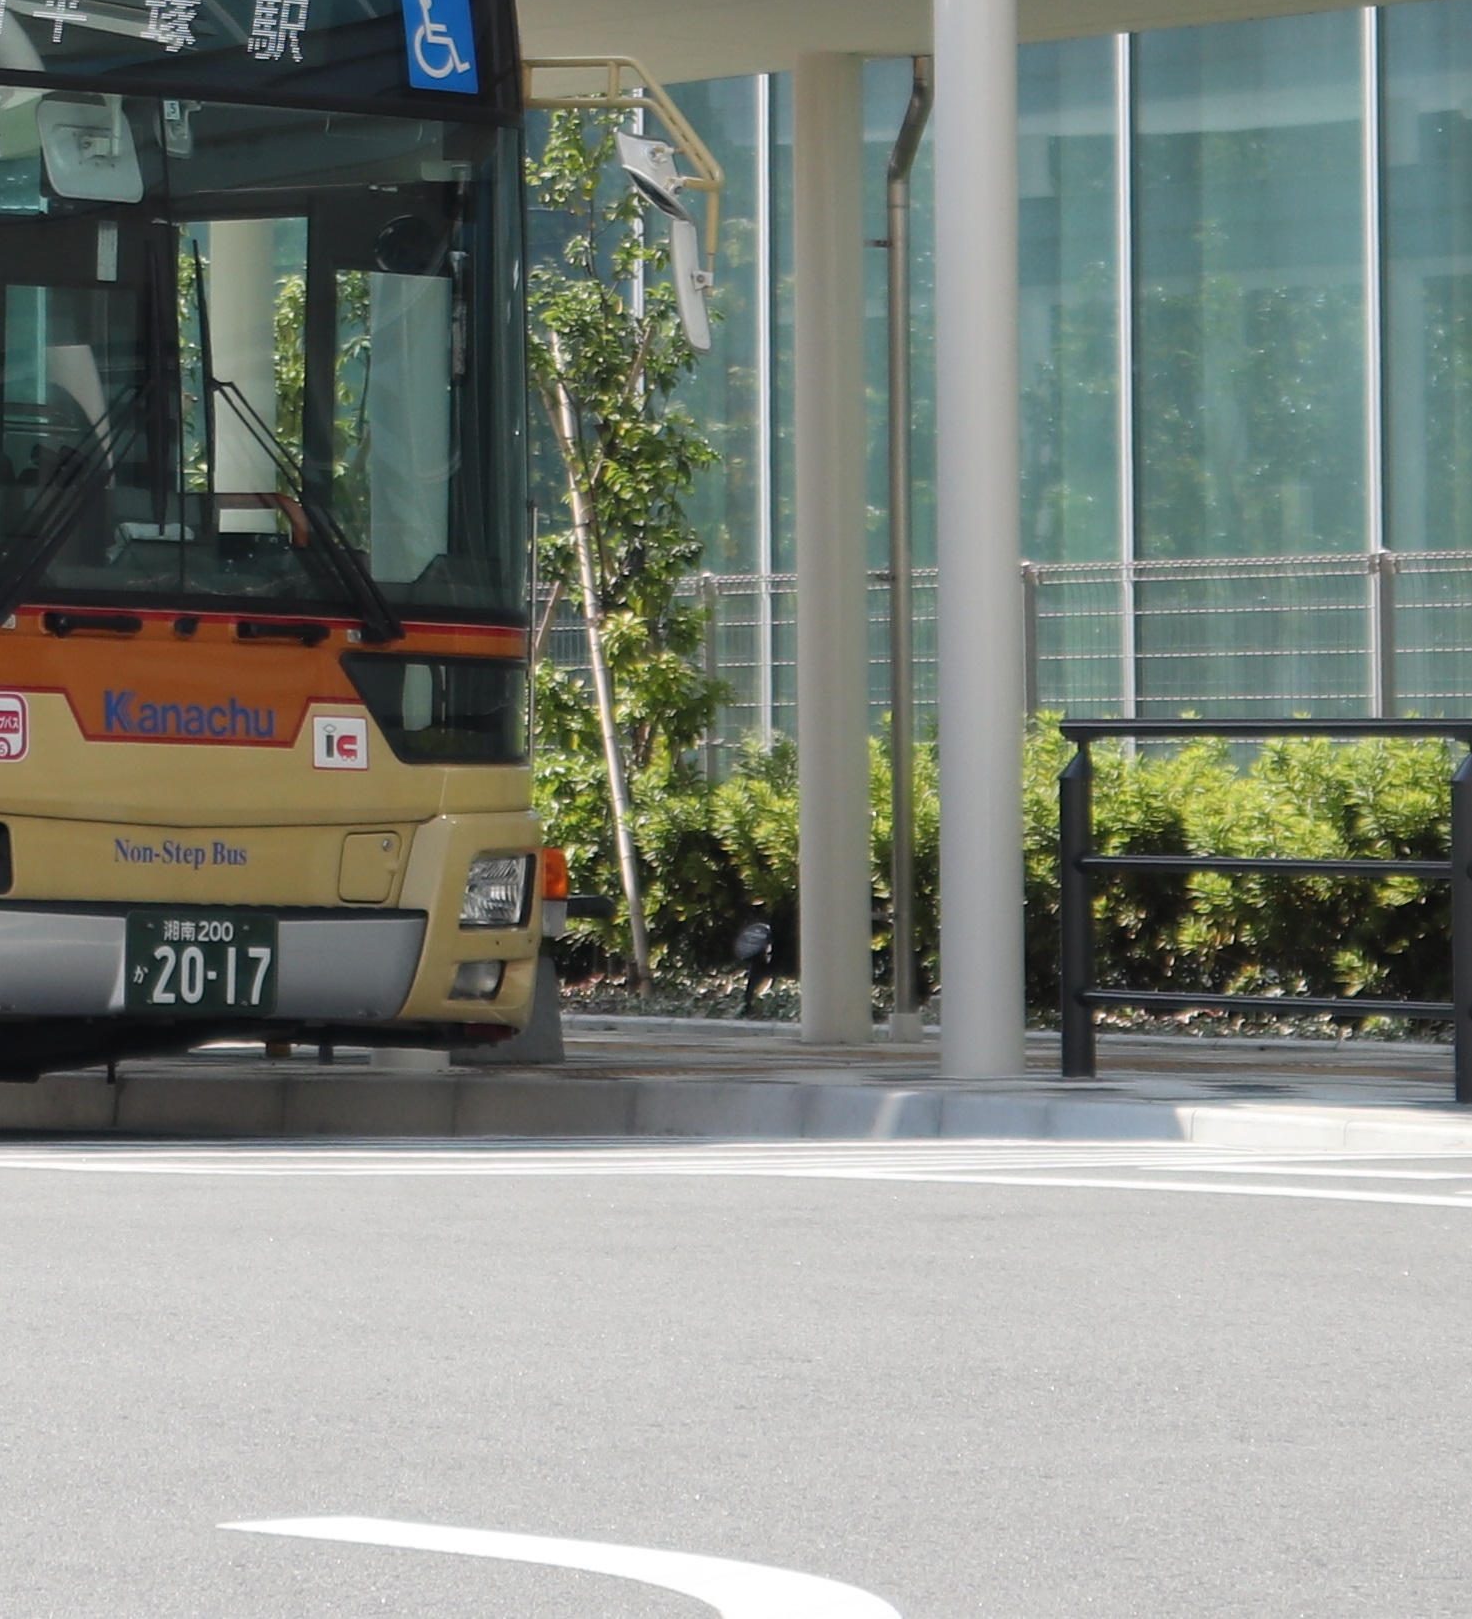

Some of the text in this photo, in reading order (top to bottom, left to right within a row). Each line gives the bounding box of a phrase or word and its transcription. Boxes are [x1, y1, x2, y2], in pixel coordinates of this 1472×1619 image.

[103, 690, 275, 738] Kanachu
[114, 838, 248, 870] Non-Step Bus
[133, 945, 272, 1005] か 20-17
